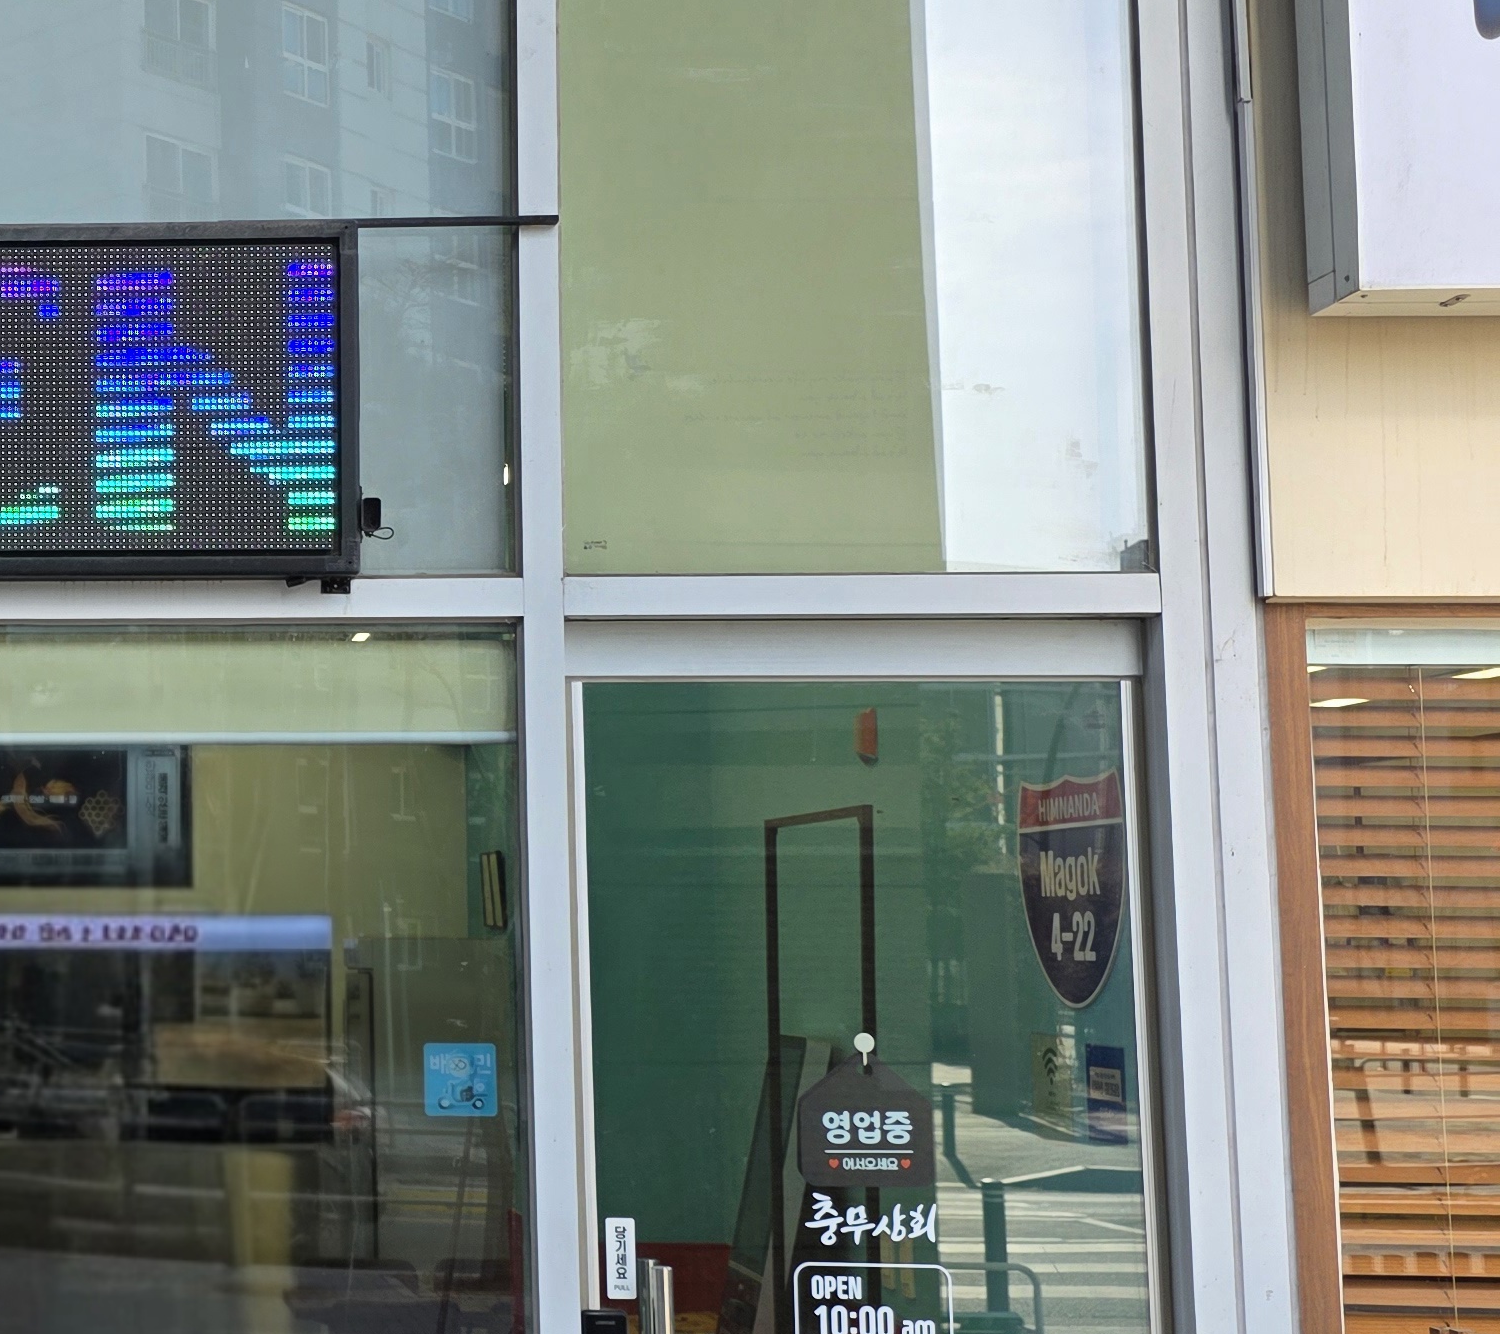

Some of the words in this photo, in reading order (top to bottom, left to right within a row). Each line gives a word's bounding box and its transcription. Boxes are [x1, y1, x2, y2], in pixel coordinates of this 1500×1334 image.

[1037, 791, 1100, 822] HIMNANDA
[1039, 847, 1101, 901] Magok
[1050, 910, 1097, 962] 4-22
[821, 1110, 914, 1145] 영업중
[842, 1156, 899, 1171] 어서오세요
[804, 1192, 937, 1246] 충무상회
[614, 1225, 628, 1280] 당기세요
[613, 1284, 631, 1292] PULL
[810, 1274, 863, 1300] OPEN
